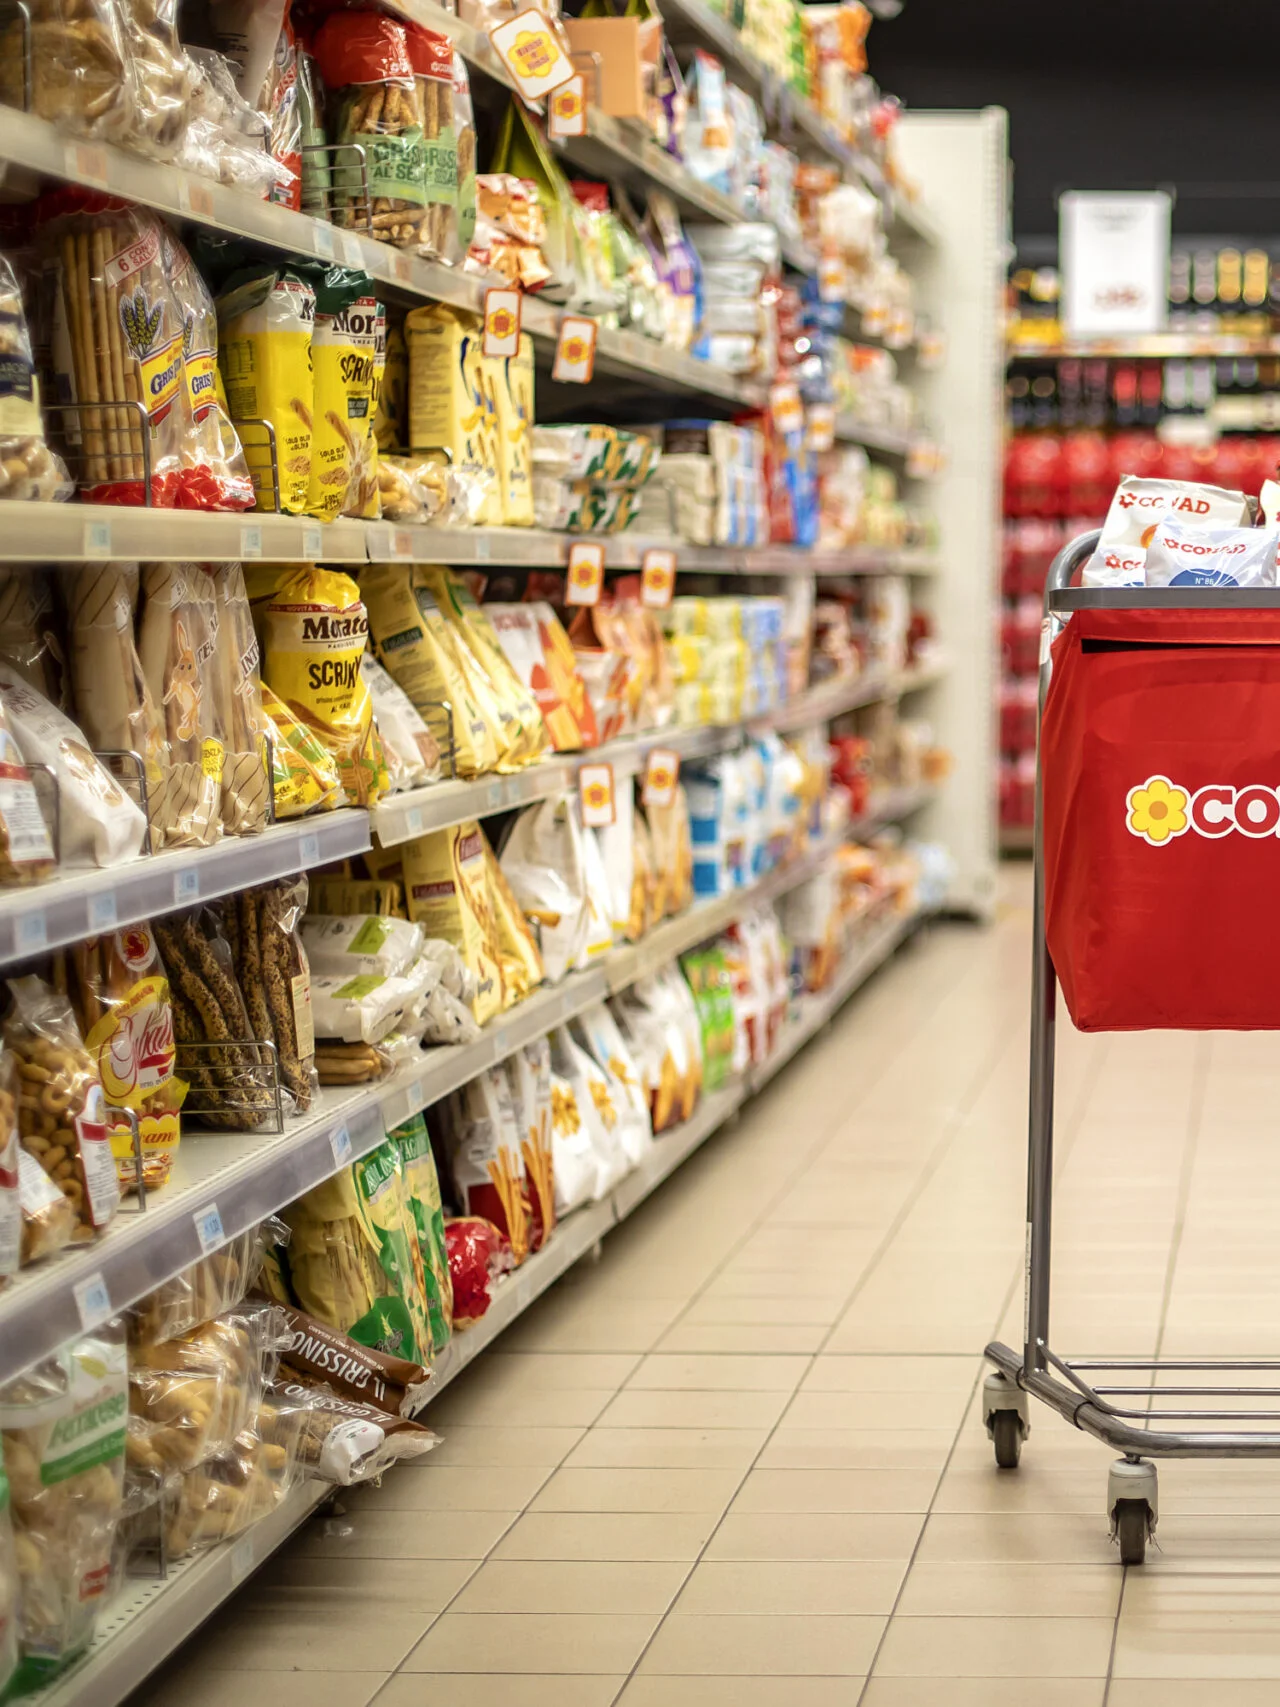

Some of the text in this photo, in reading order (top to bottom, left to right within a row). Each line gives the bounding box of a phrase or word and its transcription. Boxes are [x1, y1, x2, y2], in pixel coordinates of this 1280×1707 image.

[118, 258, 129, 273] 6
[1138, 496, 1211, 515] COAD
[302, 616, 369, 640] Morato
[292, 1331, 386, 1402] IL GRISSINO
[371, 1412, 393, 1423] IL
